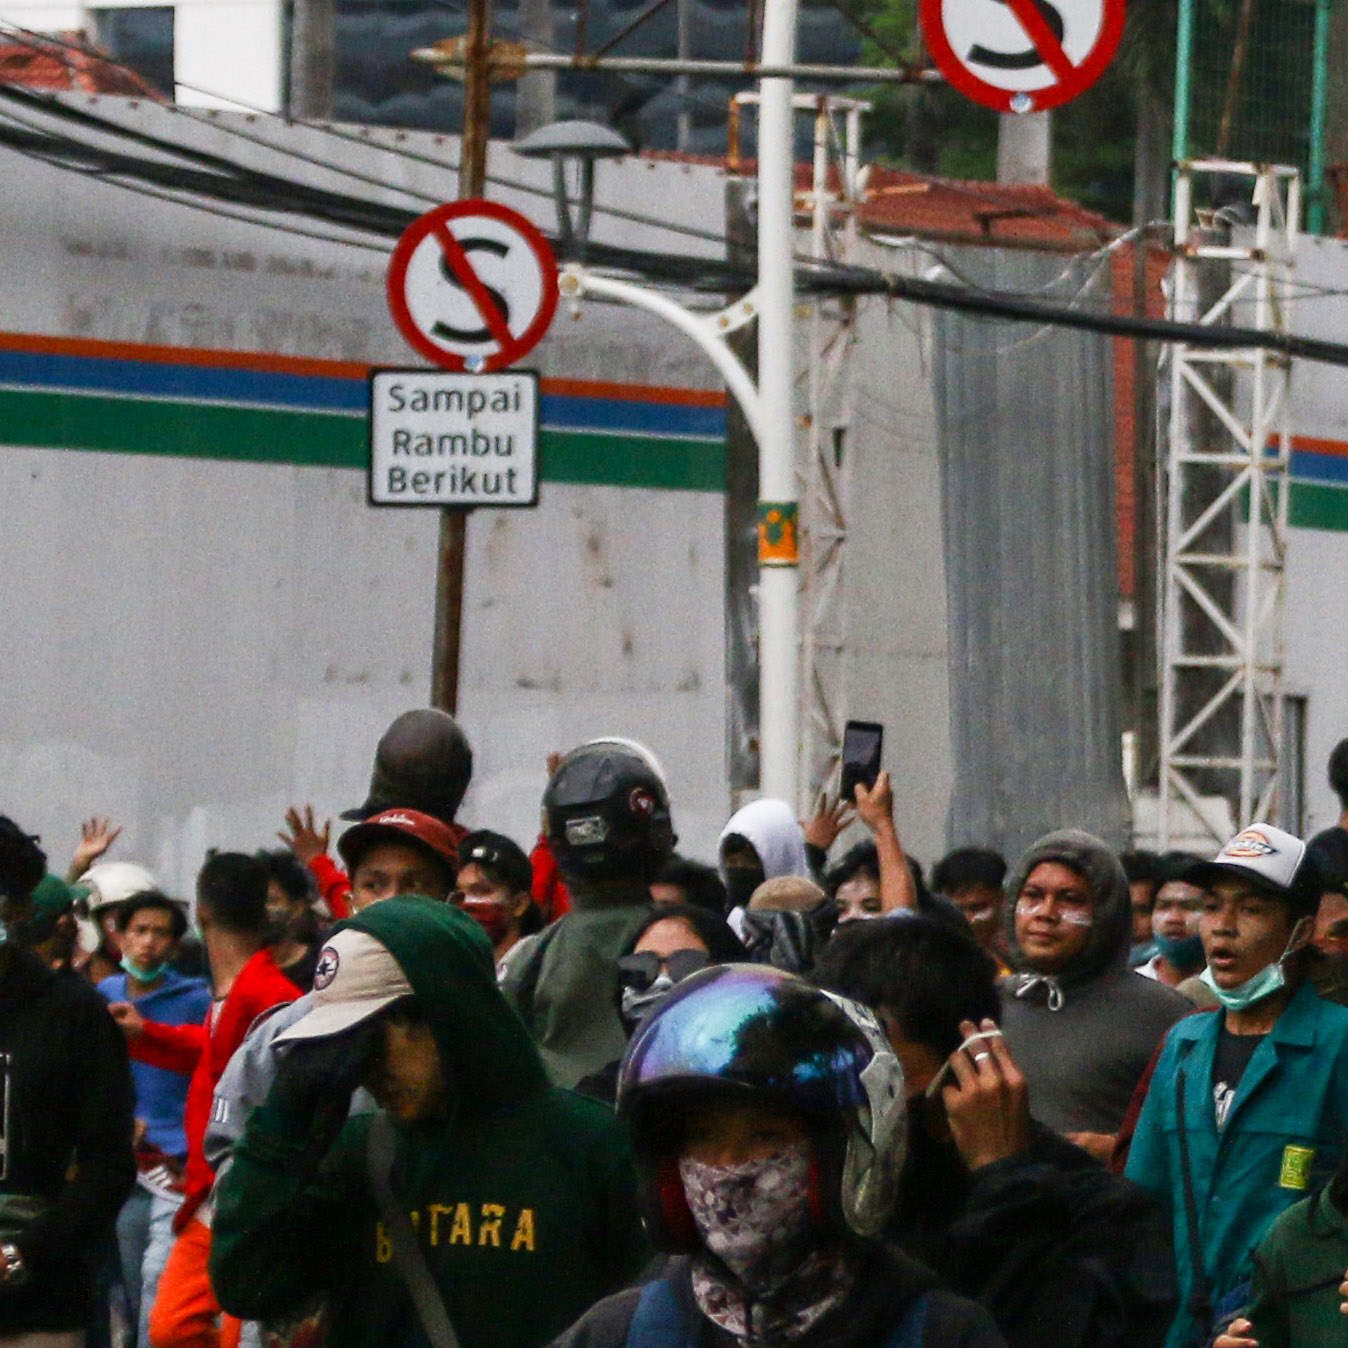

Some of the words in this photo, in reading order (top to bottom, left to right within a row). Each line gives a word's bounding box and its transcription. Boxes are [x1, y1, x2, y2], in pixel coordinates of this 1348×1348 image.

[388, 384, 521, 419] Sampai
[393, 429, 513, 456] Rambu
[388, 464, 517, 494] Berikut
